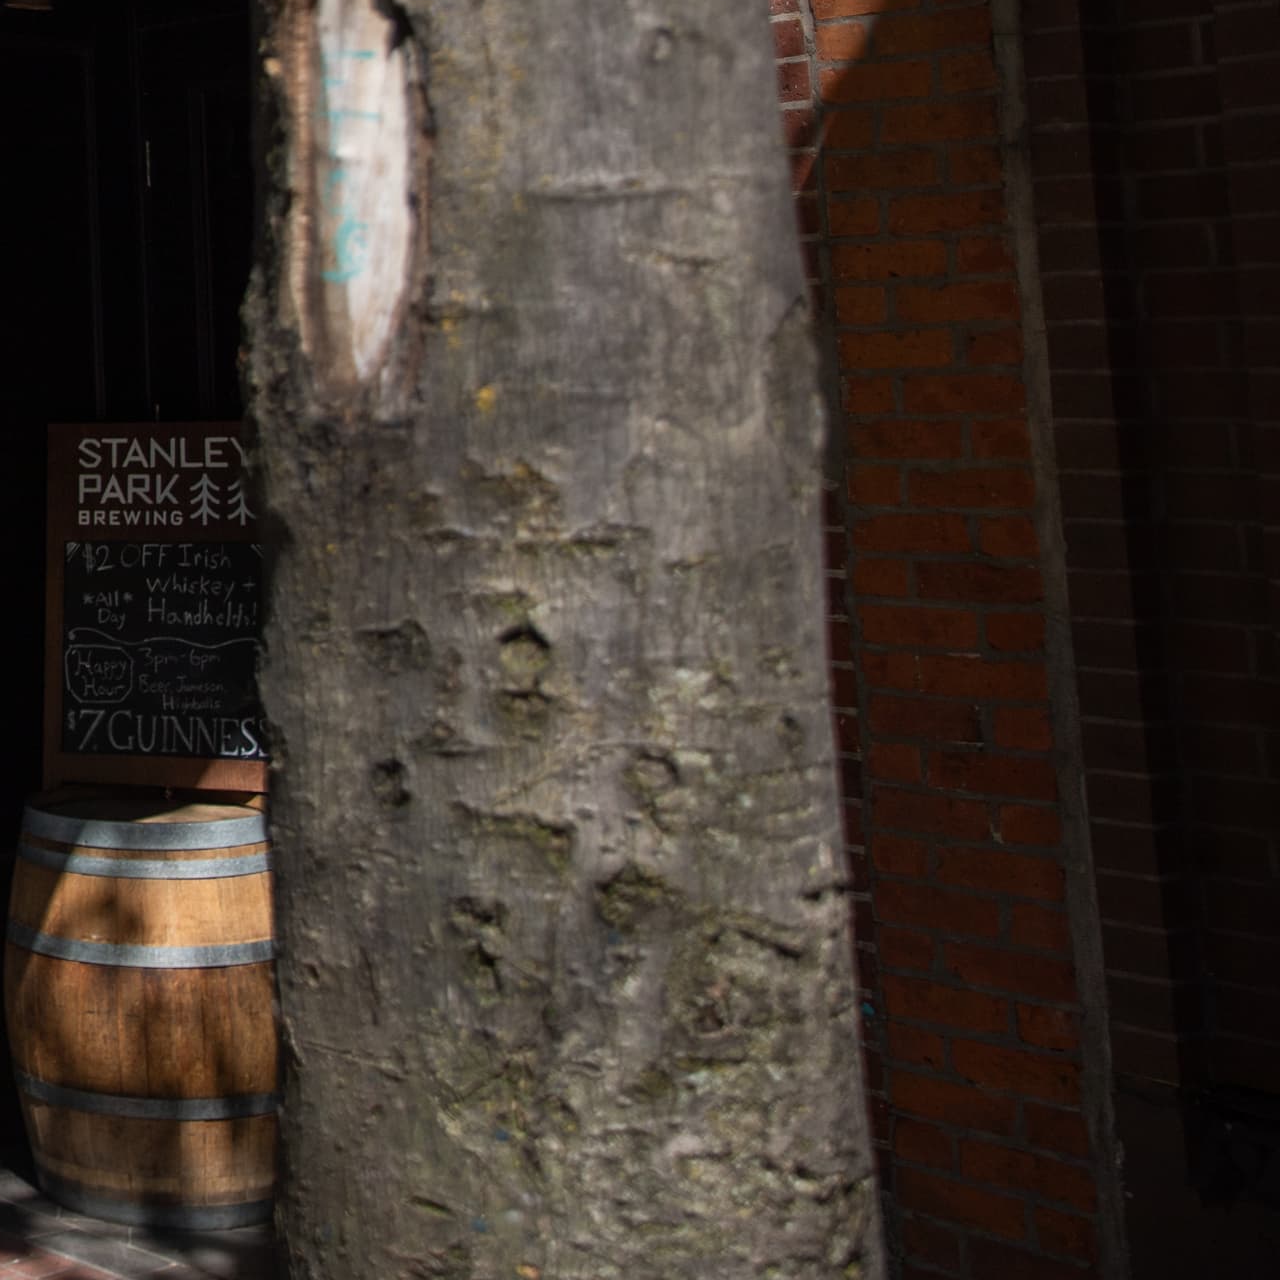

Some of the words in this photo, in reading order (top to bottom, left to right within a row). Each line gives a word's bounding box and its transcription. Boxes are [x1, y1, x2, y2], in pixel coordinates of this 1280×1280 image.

[77, 436, 248, 469] STANLEY
[78, 473, 180, 504] PARK
[78, 509, 184, 526] BREWING
[82, 544, 113, 573] $2
[120, 544, 173, 568] OFF
[177, 544, 232, 569] Irish
[146, 572, 236, 602] Whiskey
[97, 608, 126, 630] Day
[81, 675, 126, 696] Hour
